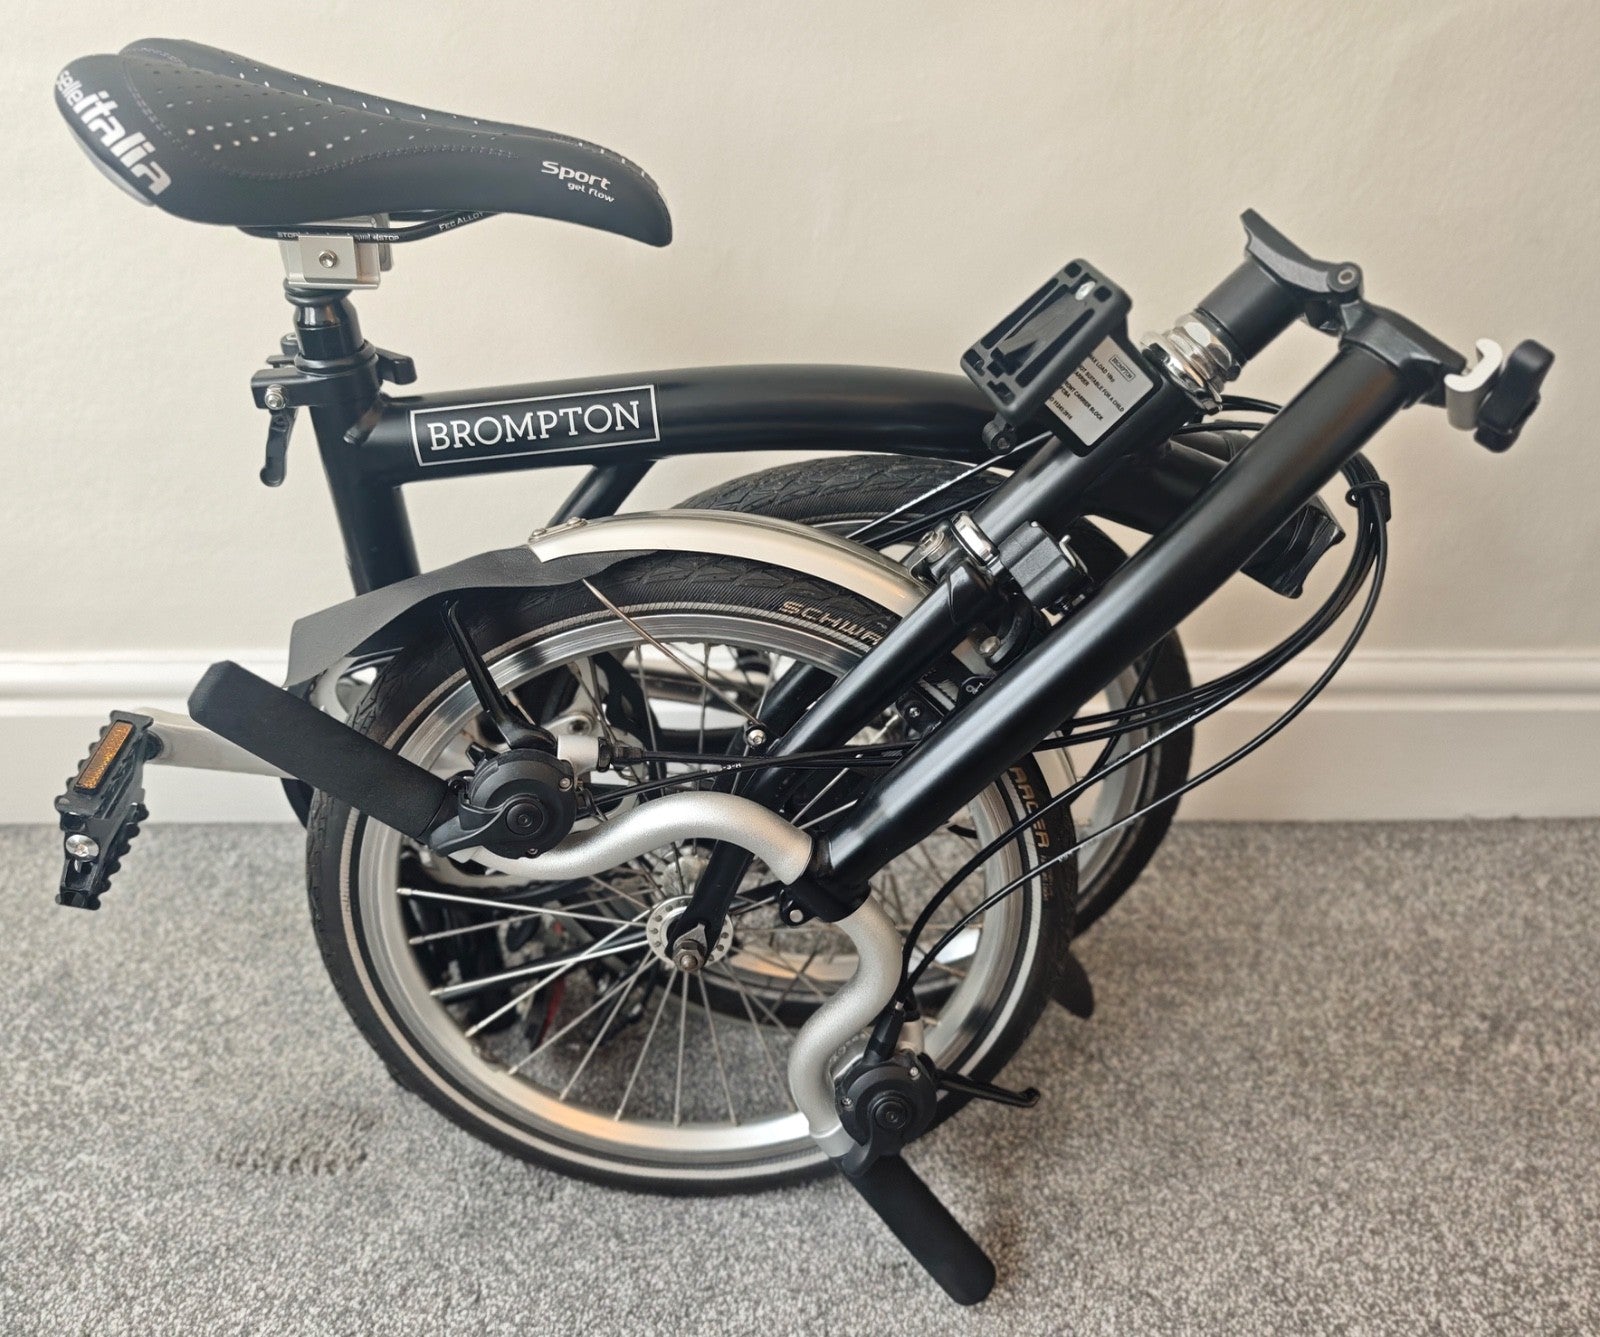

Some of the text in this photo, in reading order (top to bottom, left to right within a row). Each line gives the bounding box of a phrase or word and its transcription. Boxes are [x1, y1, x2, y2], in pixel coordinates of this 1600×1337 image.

[57, 70, 172, 195] selle italia
[541, 161, 611, 190] Sport
[1074, 371, 1090, 387] ARRIER
[1095, 361, 1108, 375] LOAD
[1064, 380, 1076, 393] RONT
[1089, 406, 1104, 421] BLOCK
[1078, 365, 1087, 374] OT
[1085, 371, 1104, 391] SUITABLE
[1101, 388, 1112, 400] FOR
[1112, 399, 1125, 413] CHILD
[427, 401, 639, 451] BROMPTON
